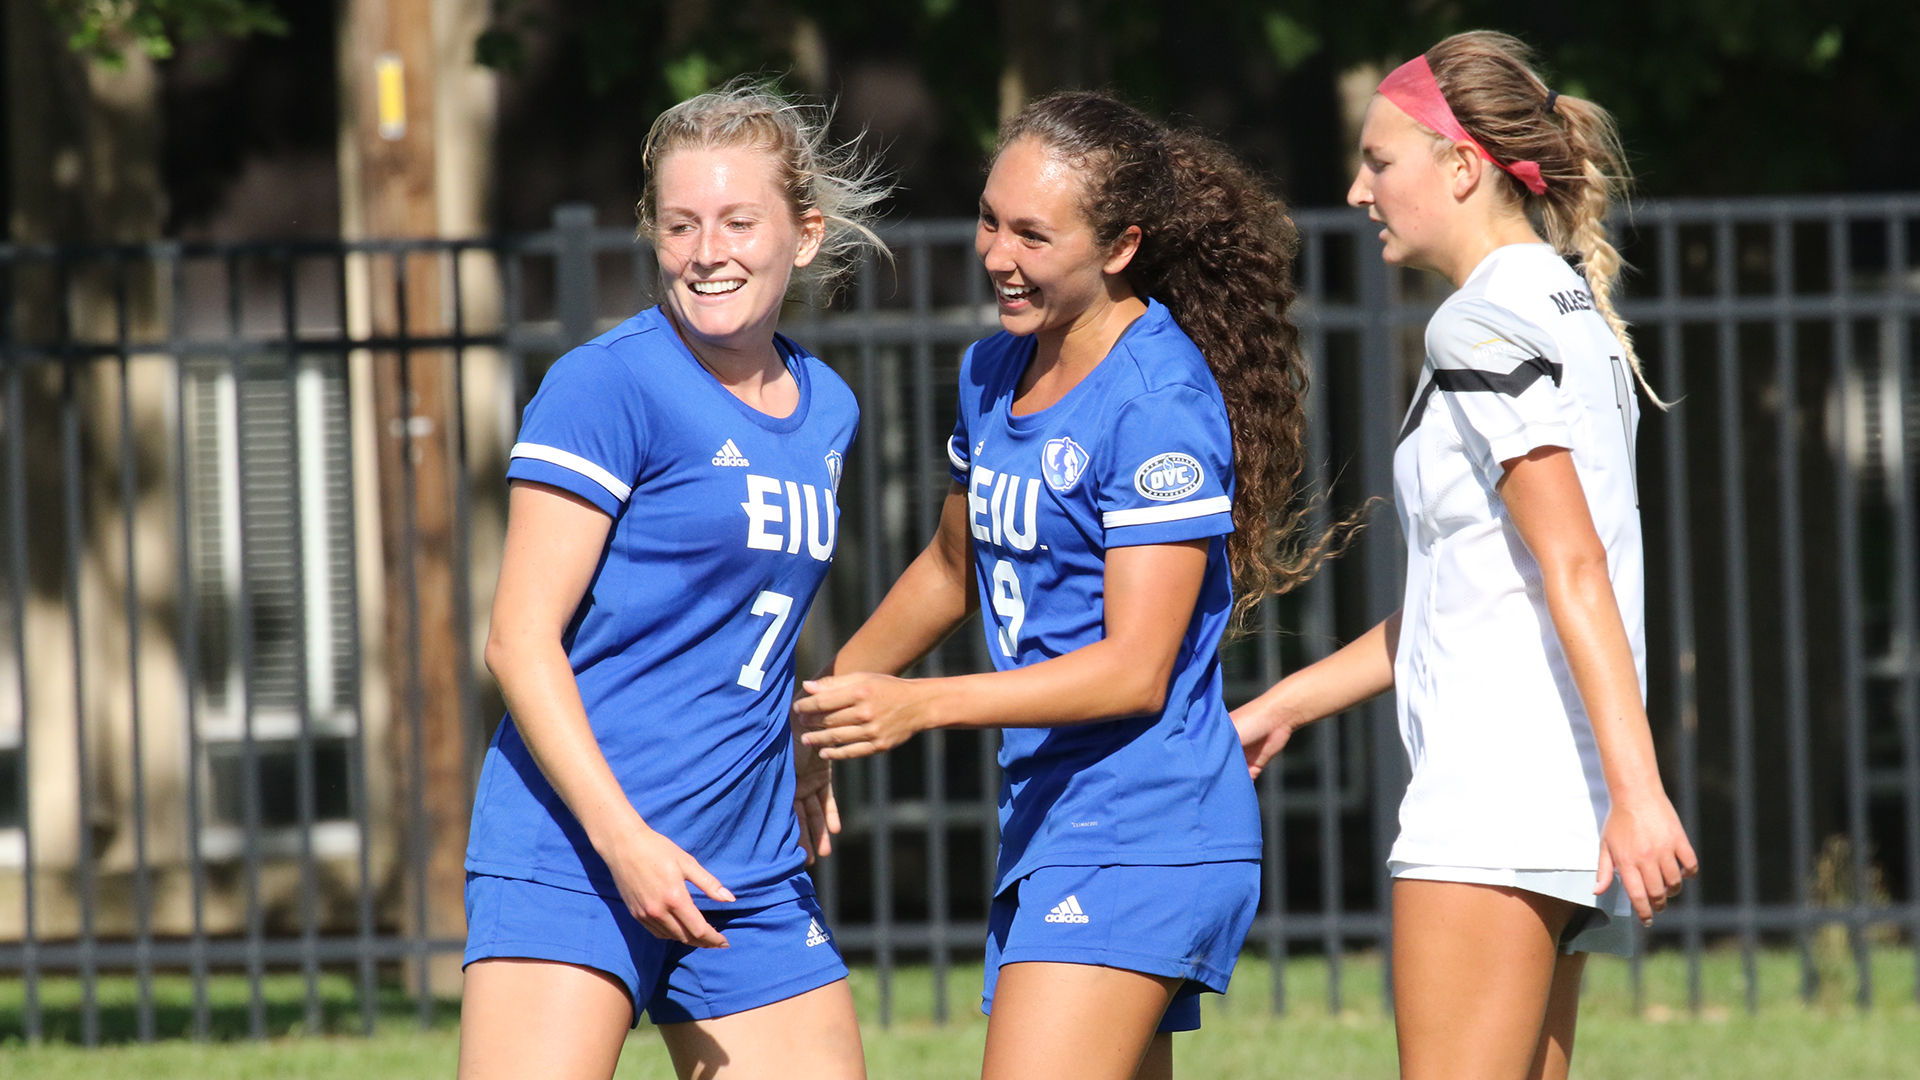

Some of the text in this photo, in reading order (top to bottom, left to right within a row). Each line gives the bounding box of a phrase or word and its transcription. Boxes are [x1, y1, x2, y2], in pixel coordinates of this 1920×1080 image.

[1549, 289, 1591, 315] MAS
[711, 455, 750, 467] adidas
[1610, 356, 1639, 509] 1
[741, 474, 835, 562] EIU
[968, 465, 1042, 551] EIU
[1150, 465, 1190, 490] OVC
[737, 590, 794, 691] 7
[993, 559, 1025, 658] 9
[1044, 912, 1089, 923] adidas
